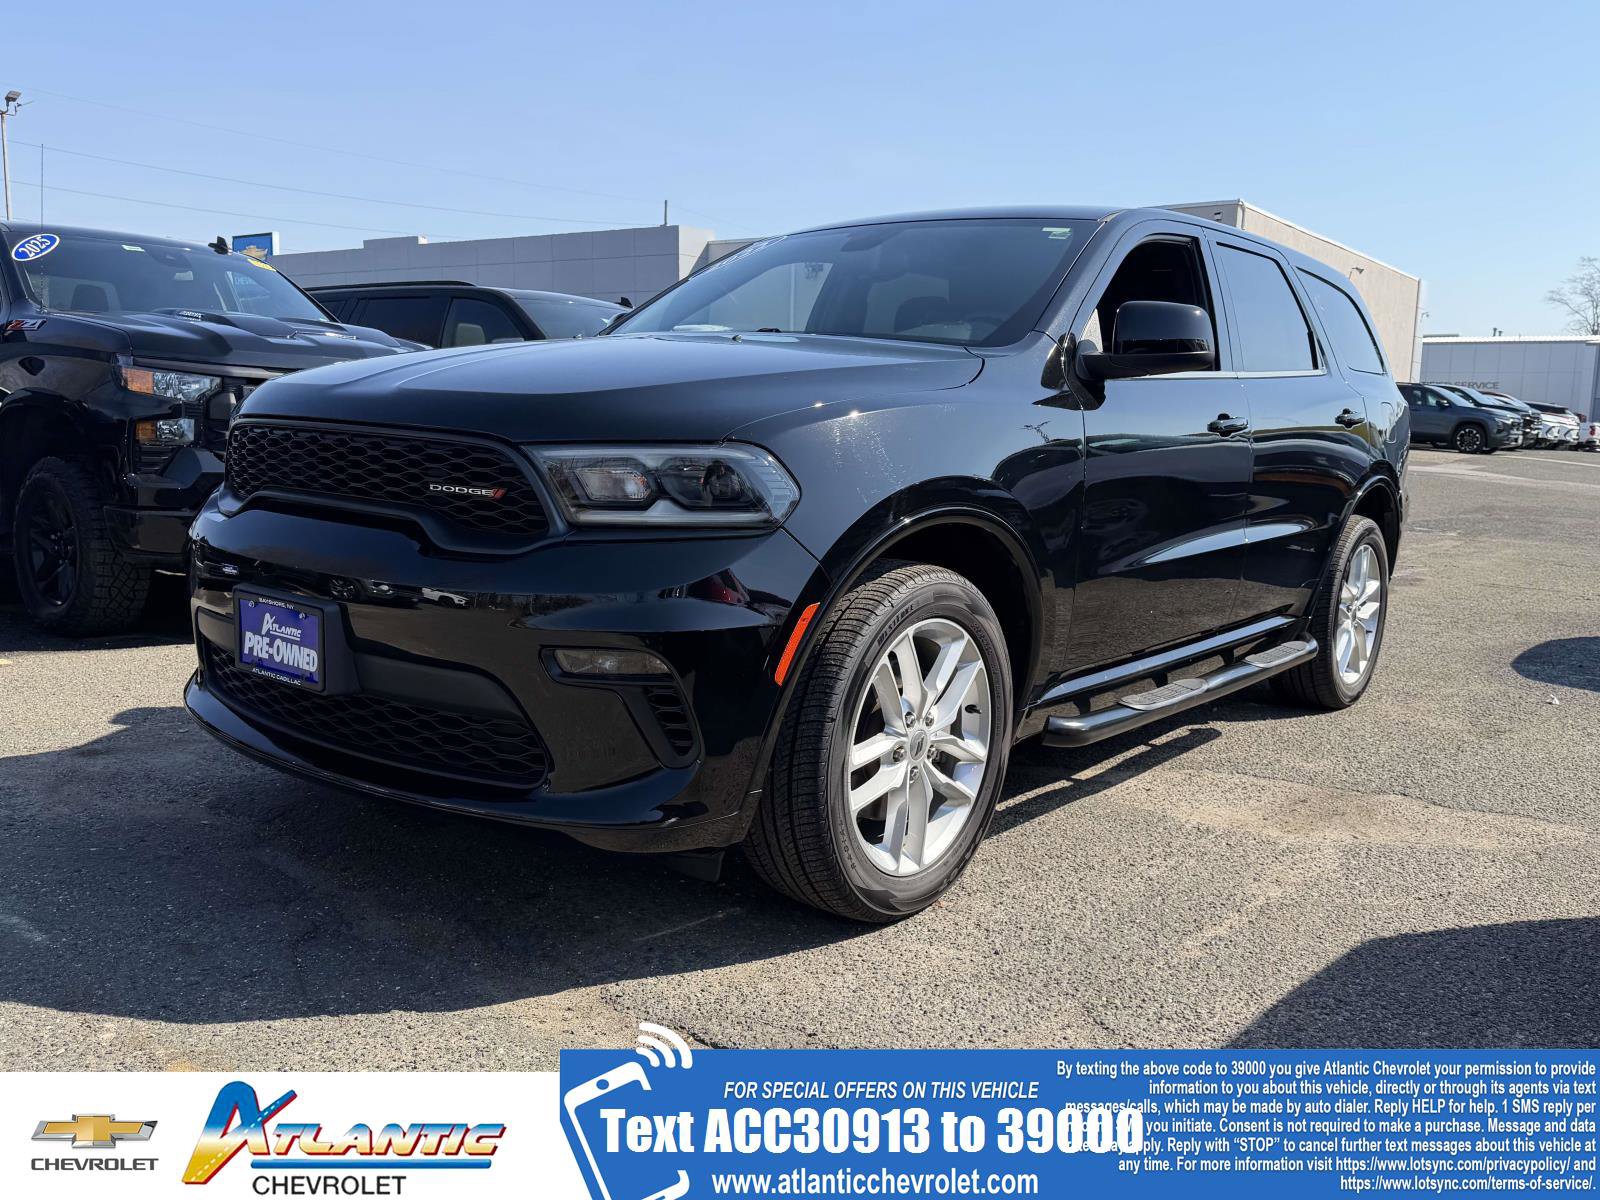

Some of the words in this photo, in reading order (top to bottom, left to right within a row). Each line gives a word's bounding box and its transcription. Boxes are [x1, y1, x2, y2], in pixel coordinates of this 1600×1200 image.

[19, 236, 51, 258] 2025
[429, 484, 493, 496] DODGE
[261, 612, 302, 638] ATLANTIC
[244, 631, 318, 672] PRE-OWNED
[252, 668, 276, 679] ATLANTIC
[277, 674, 302, 685] CADILLAC
